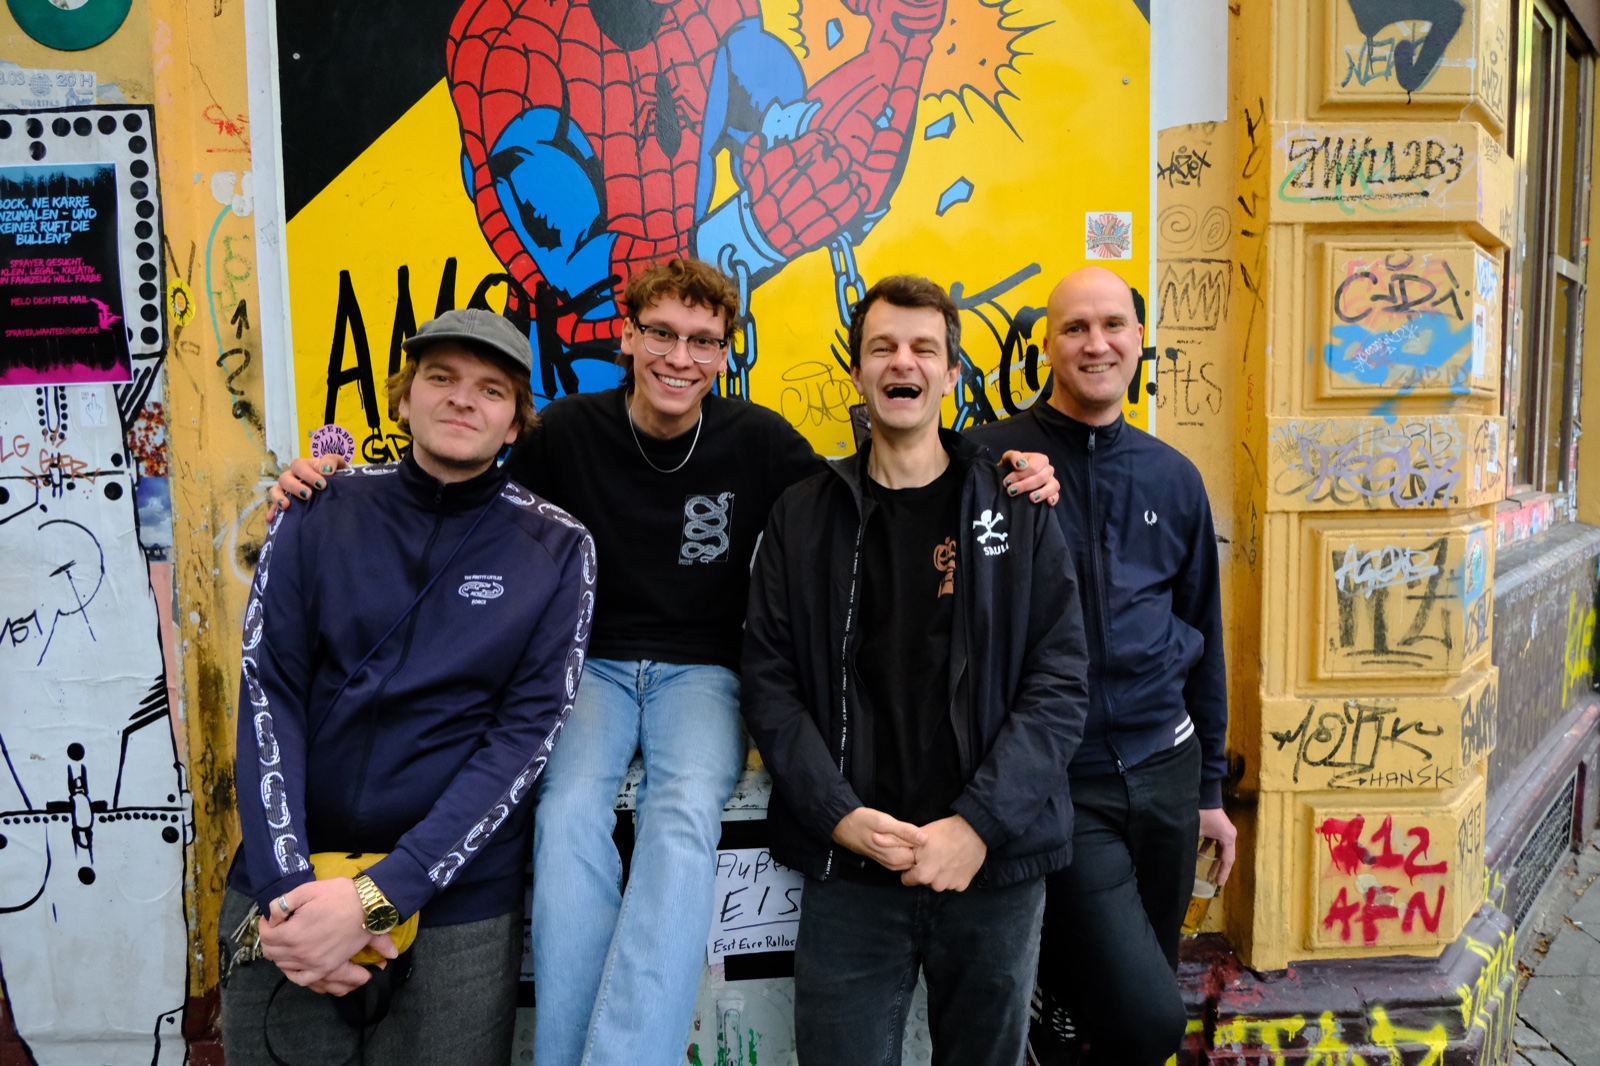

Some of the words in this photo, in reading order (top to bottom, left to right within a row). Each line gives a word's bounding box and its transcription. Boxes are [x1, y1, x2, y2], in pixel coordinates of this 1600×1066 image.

[56, 74, 77, 88] 20
[81, 75, 93, 88] H
[32, 197, 49, 209] NE
[52, 195, 90, 209] KARRE
[72, 207, 97, 220] UND
[40, 220, 69, 233] RUFT
[70, 220, 90, 232] DIE
[16, 232, 71, 246] BULLEN?
[10, 258, 45, 268] SPRAYER
[62, 265, 95, 275] KREATIV
[10, 275, 51, 285] FAHRZEUG
[53, 274, 73, 283] WILL
[75, 273, 102, 283] FARBE
[11, 297, 31, 306] MELD
[33, 296, 51, 305] DICH
[53, 295, 69, 304] PER
[70, 295, 89, 304] MAIL
[720, 886, 802, 923] EIS
[713, 938, 736, 954] Esst
[765, 934, 796, 948] Rollos
